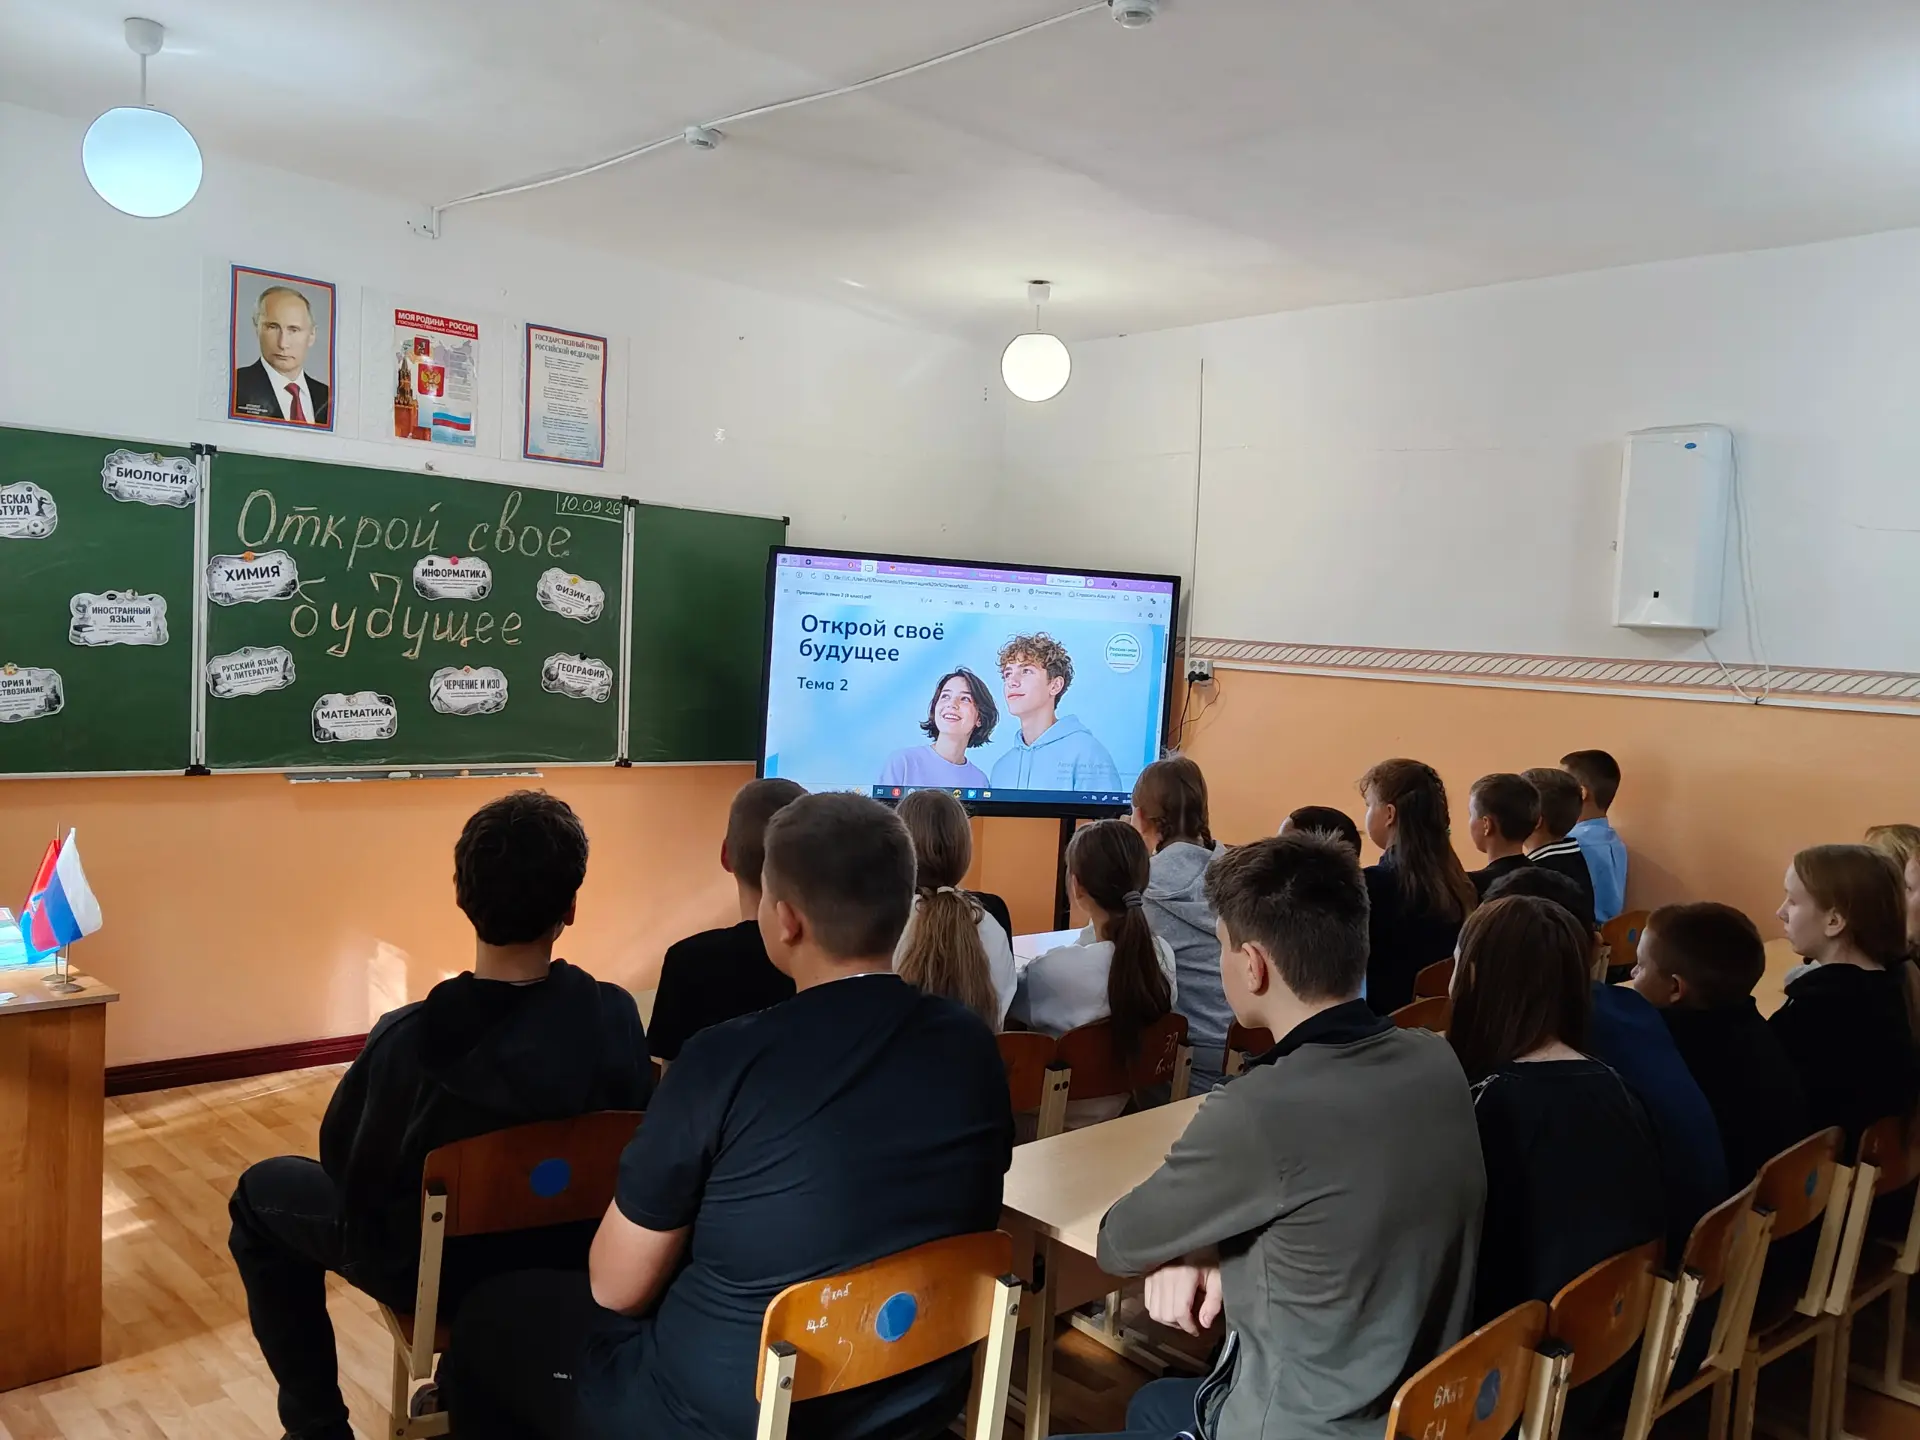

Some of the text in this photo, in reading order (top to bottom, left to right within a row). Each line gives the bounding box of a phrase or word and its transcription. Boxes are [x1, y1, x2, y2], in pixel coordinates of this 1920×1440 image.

[398, 312, 415, 321] МОЯ
[416, 315, 445, 327] РОДИНА
[449, 321, 475, 333] РОССИЯ
[116, 467, 188, 485] БИОЛОГИЯ
[237, 489, 572, 571] Открой свое
[224, 565, 281, 582] ХИМИЯ
[421, 568, 487, 579] ИНФОРМАТИКА
[555, 584, 591, 603] ФИЗИКА
[92, 606, 151, 615] ИНОСТРАННЫЙ
[289, 572, 523, 660] будущее
[109, 615, 135, 623] ЯЗЫК
[801, 614, 944, 640] Открой своё
[799, 638, 900, 663] будущее
[222, 657, 279, 673] РУССКИЙ ЯЗЫК
[233, 666, 279, 680] ЛИТЕРАТУРА
[557, 662, 605, 679] ГЕОГРАФИЯ
[26, 679, 32, 687] И
[444, 679, 500, 690] ЧЕРЧЕНИЕ И ИЗО
[797, 676, 848, 691] Тема 2
[321, 708, 392, 720] МАТЕМАТИКА
